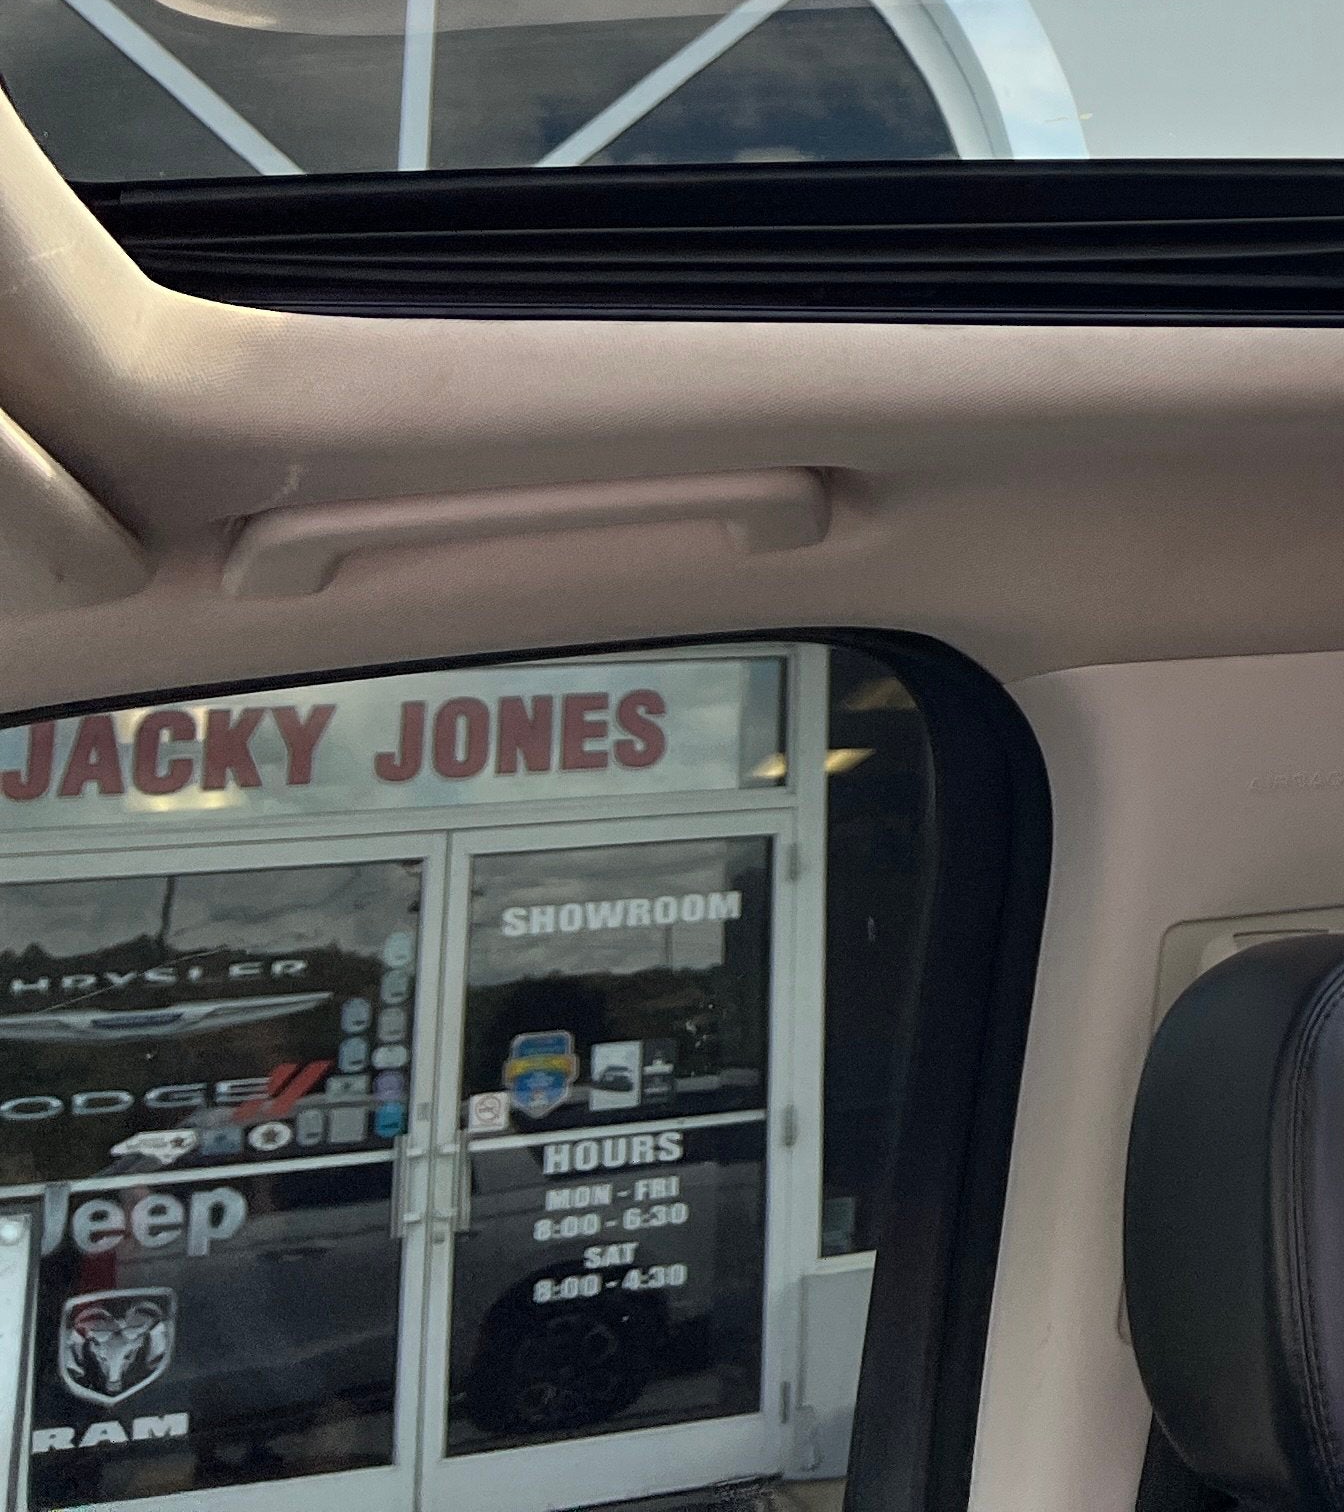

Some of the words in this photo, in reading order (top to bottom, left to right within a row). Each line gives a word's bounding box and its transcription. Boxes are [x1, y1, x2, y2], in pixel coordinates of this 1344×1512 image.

[0, 704, 336, 802] JACKY
[374, 688, 668, 784] JONES
[502, 890, 743, 937] SHOWROOM
[542, 1132, 684, 1175] HOURS
[545, 1183, 613, 1211] MON
[634, 1175, 681, 1202] FRI
[622, 1202, 690, 1231] 6:30
[584, 1241, 639, 1270] SAT
[621, 1263, 688, 1291] 4:30
[32, 1412, 190, 1454] RAM
